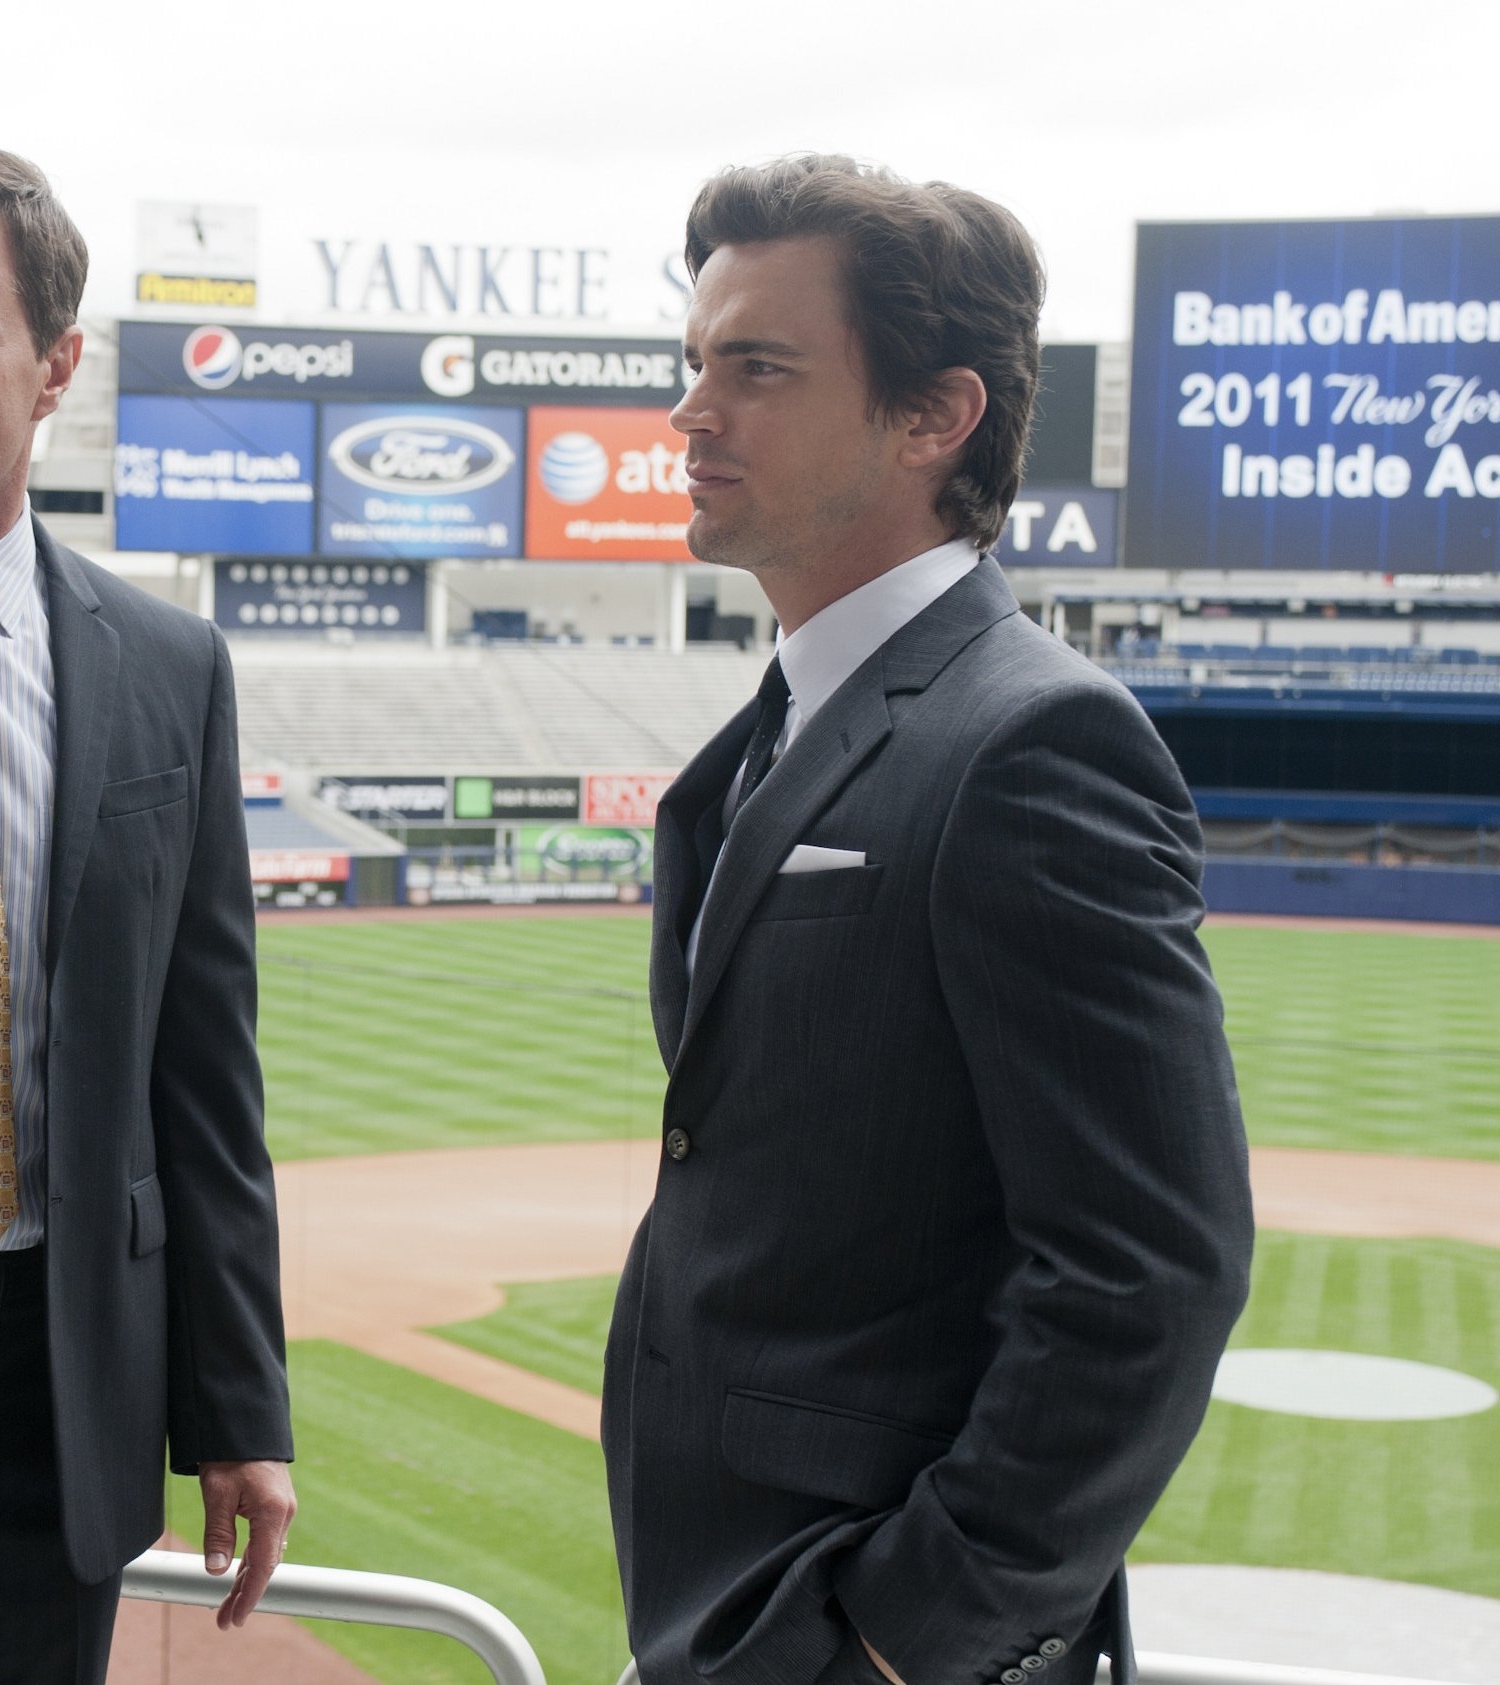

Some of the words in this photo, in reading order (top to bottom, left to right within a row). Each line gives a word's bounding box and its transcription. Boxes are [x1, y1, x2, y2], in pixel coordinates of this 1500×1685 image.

[314, 239, 609, 320] YANKEE
[1173, 292, 1307, 346] Bank
[1308, 289, 1367, 345] of
[244, 340, 354, 382] pepsi
[421, 336, 475, 397] G
[481, 352, 675, 388] GATORADE
[1177, 371, 1313, 428] 2011
[1322, 374, 1426, 426] New
[161, 449, 235, 478] Merrill
[235, 450, 300, 481] Lynch
[370, 431, 472, 480] Ford
[1222, 444, 1412, 499] Inside
[364, 498, 424, 521] Drive
